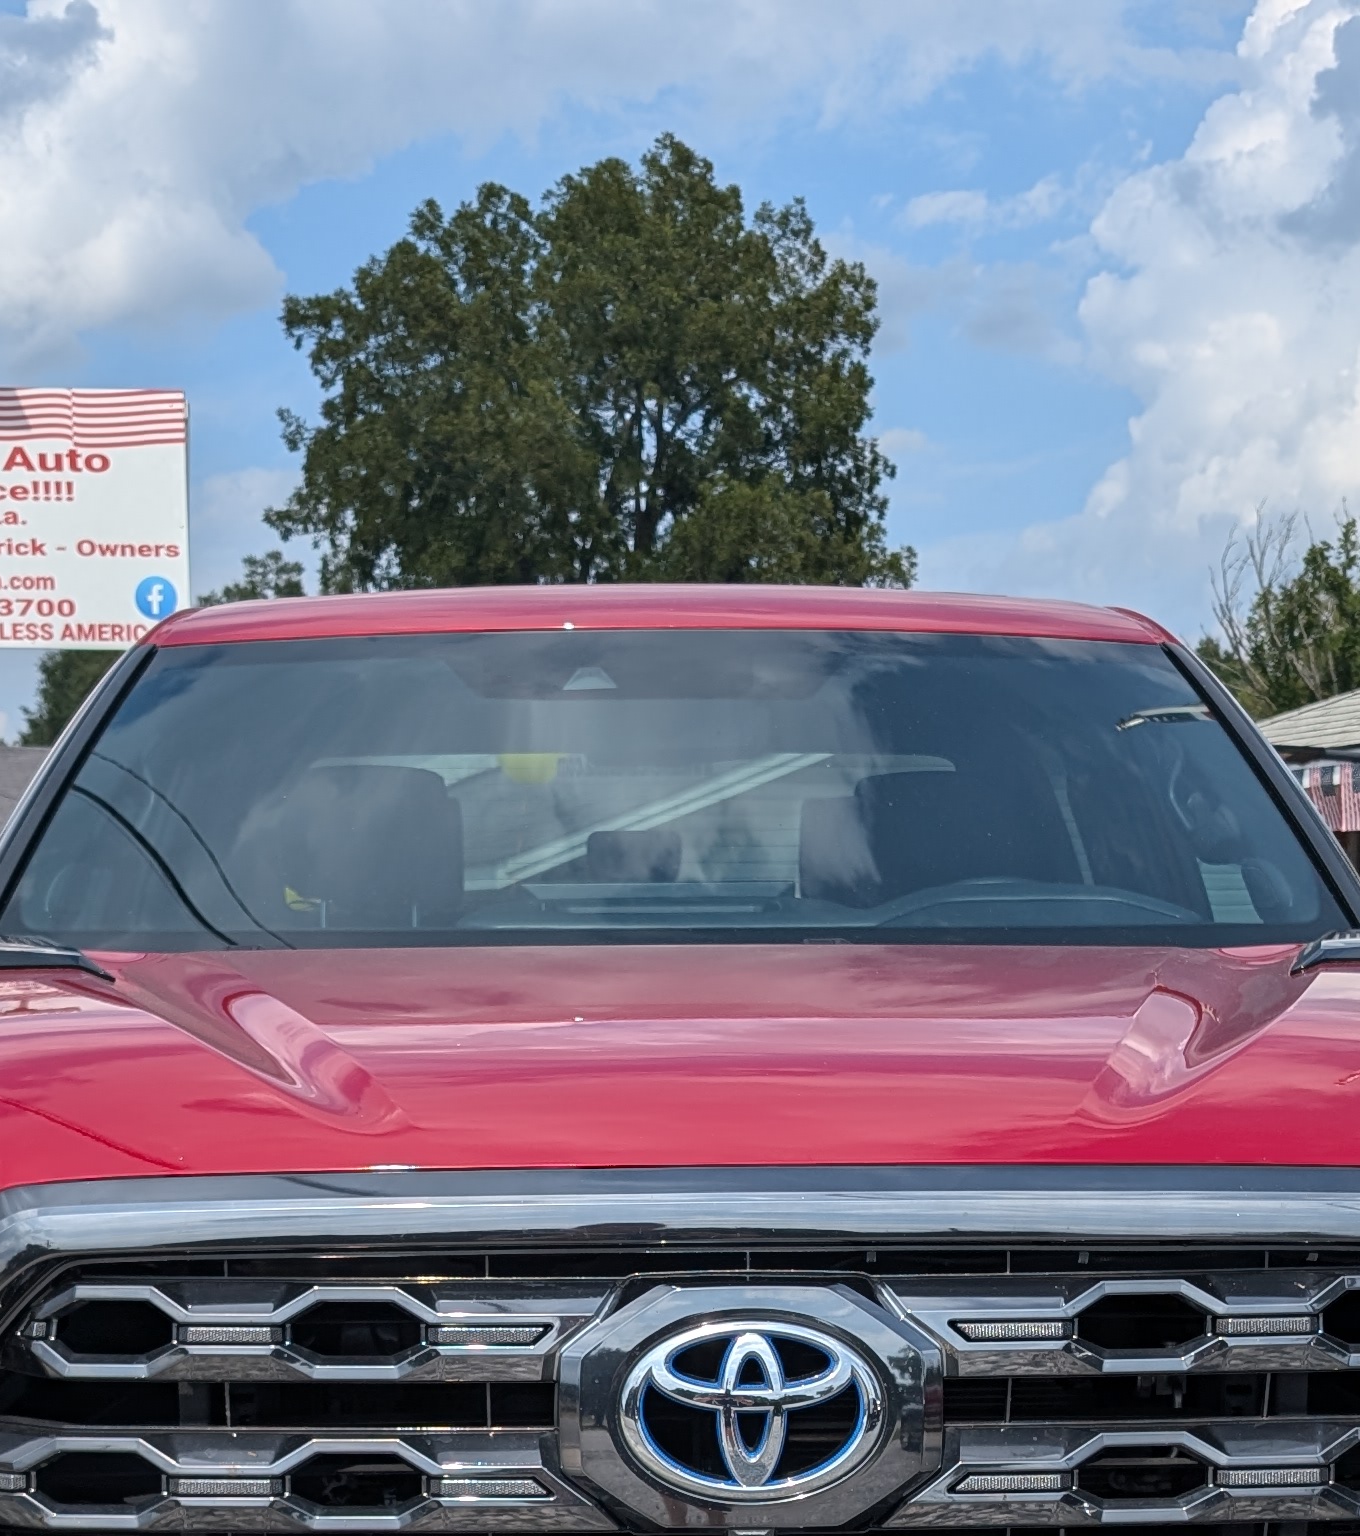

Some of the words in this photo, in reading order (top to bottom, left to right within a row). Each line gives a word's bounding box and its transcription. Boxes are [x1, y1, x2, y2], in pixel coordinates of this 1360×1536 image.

[1, 445, 112, 474] Auto
[76, 539, 181, 558] Owners
[60, 623, 147, 643] AMERIC
